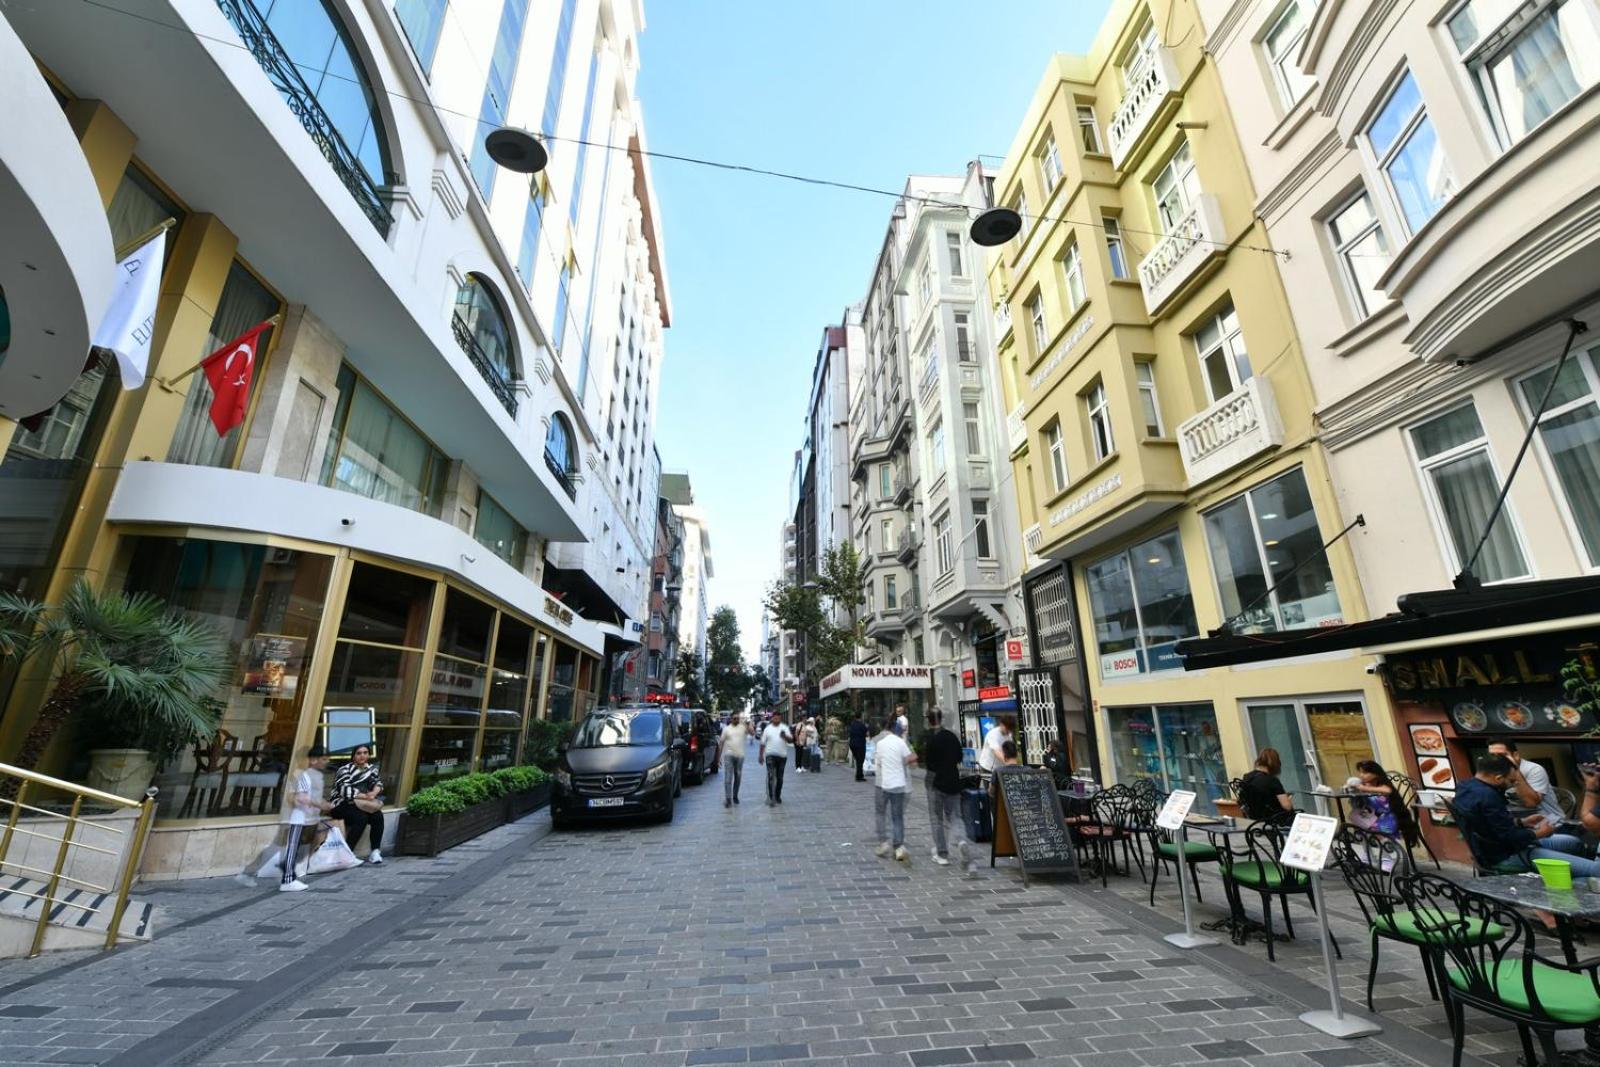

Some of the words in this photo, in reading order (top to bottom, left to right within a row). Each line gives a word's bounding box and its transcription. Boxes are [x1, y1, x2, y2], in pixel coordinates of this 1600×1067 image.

[1113, 657, 1137, 671] BOSCH
[852, 667, 874, 677] NOVA
[876, 667, 904, 677] PLAZA
[906, 667, 928, 678] PARK
